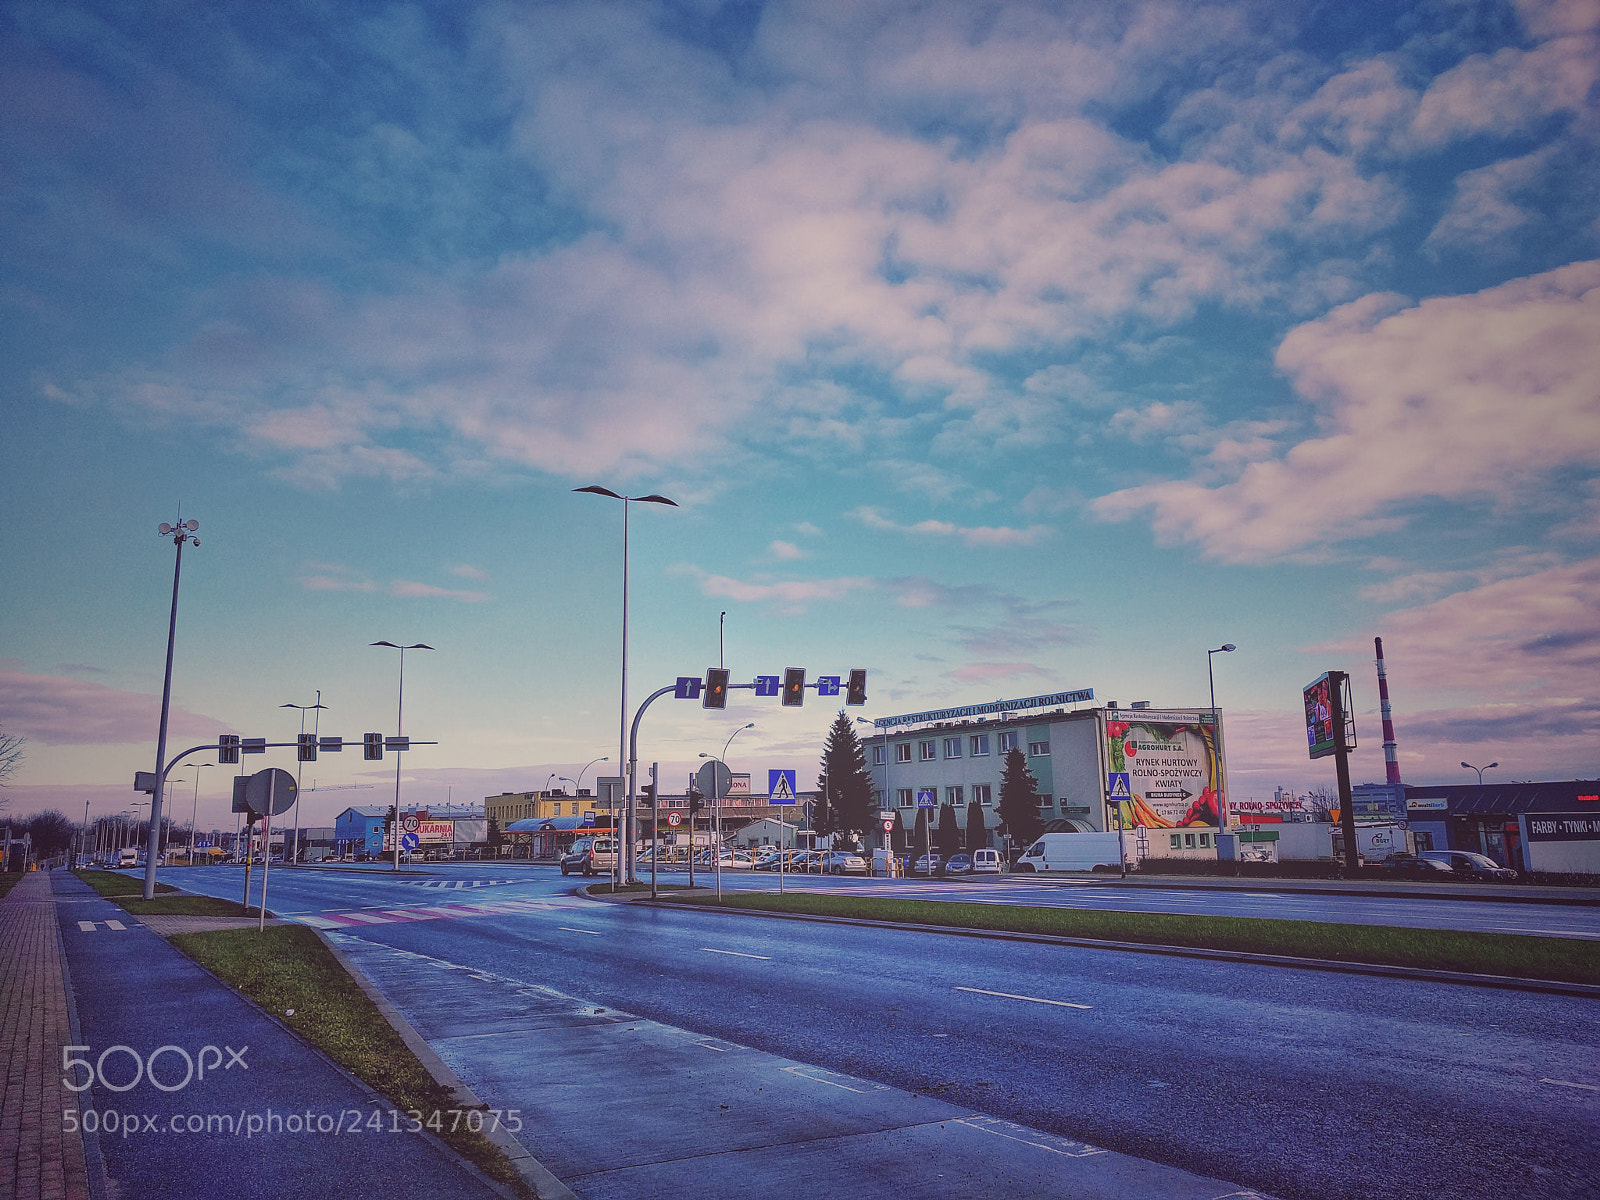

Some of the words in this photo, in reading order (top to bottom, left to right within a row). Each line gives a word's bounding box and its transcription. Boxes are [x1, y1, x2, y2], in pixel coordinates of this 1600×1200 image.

[903, 708, 971, 723] RESTRUKTURYZACJI
[975, 699, 1037, 714] MODERNIZACJI
[1037, 691, 1091, 707] ROLNICTWA
[1136, 758, 1160, 766] RYNEK
[1161, 759, 1198, 767] HURTOWY
[1132, 768, 1203, 778] ROLNO-SPOŻYWCZY
[1155, 780, 1183, 788] KWIATY
[406, 819, 418, 828] 70
[671, 815, 680, 823] 70
[1531, 820, 1557, 834] FARBY
[1563, 820, 1588, 833] TYNKI
